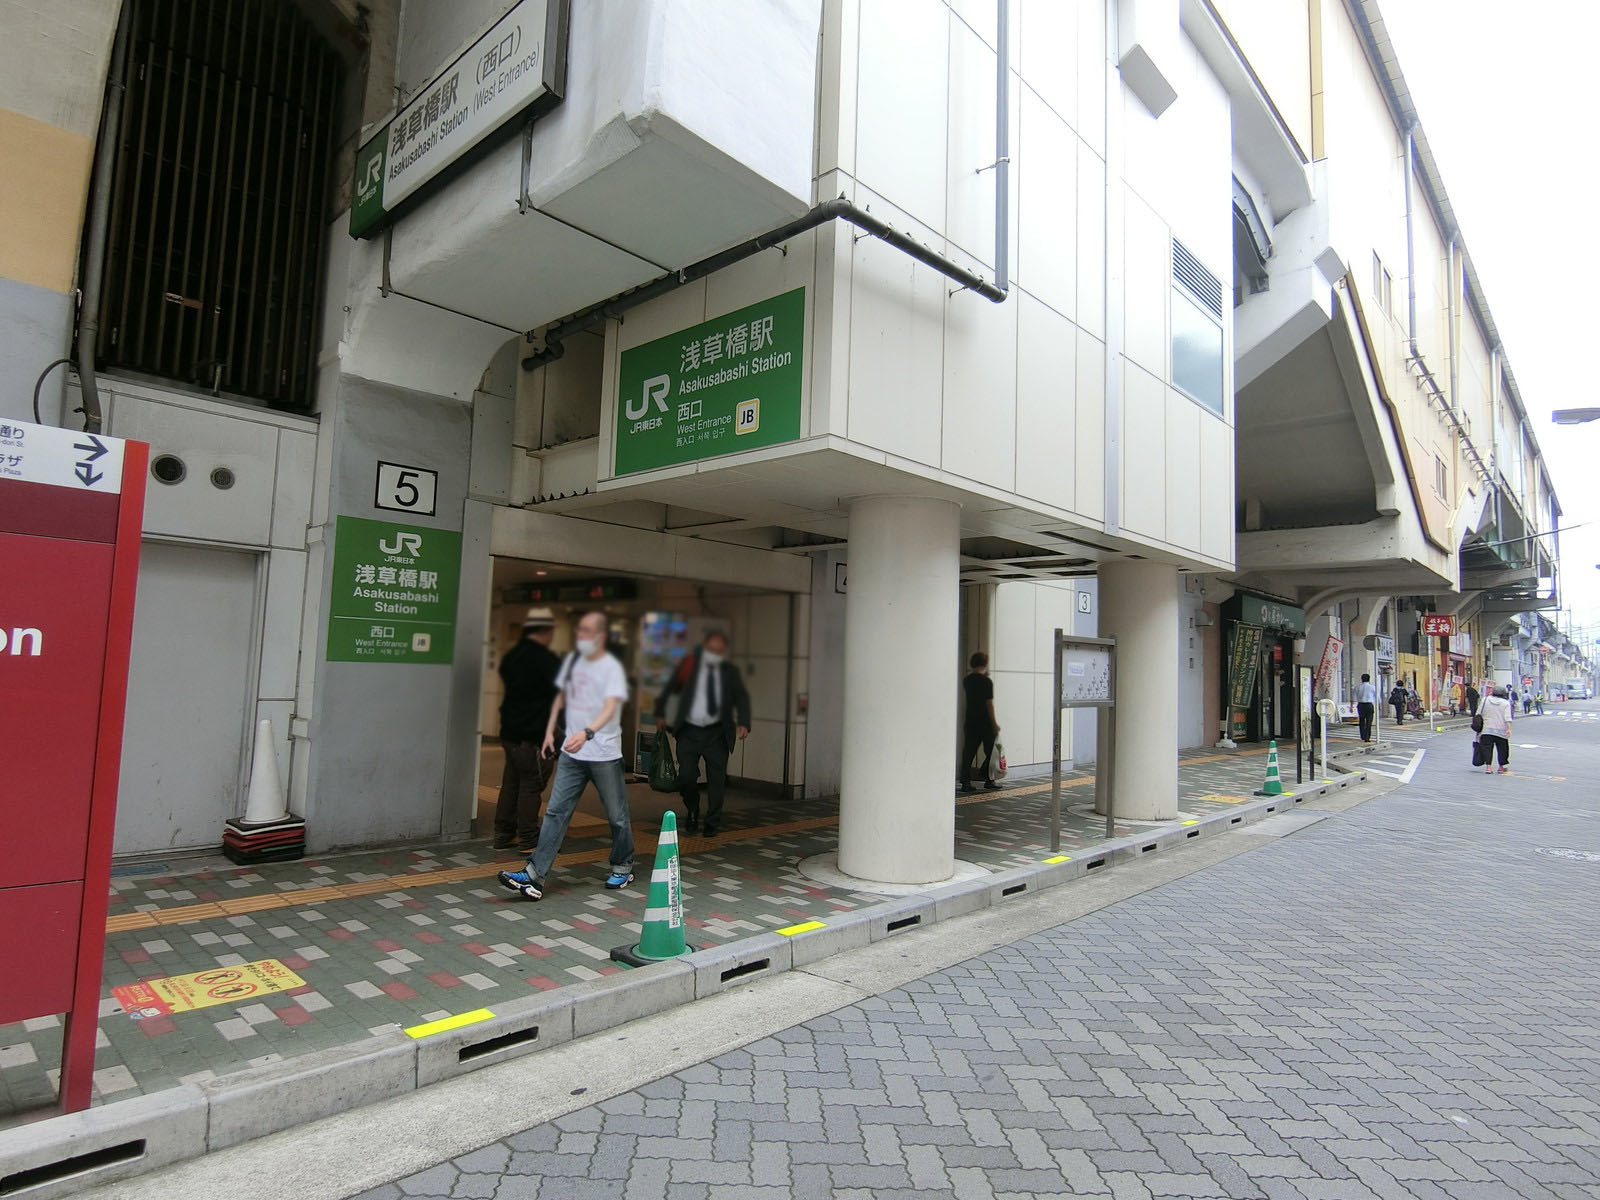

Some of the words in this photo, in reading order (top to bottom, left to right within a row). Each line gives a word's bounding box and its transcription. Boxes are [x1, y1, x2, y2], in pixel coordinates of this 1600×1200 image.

[388, 128, 439, 183] Asakusabashi
[439, 106, 469, 141] Station
[473, 82, 497, 116] (West
[498, 42, 540, 94] Entrance)
[390, 71, 460, 158] 浅草橋駅
[357, 152, 382, 196] JR
[679, 315, 774, 373] 浅草橋駅
[678, 360, 749, 396] Asakusabashi
[751, 351, 792, 375] Station
[625, 373, 671, 420] JR
[677, 399, 703, 423] 西口
[740, 408, 754, 425] JB
[629, 416, 663, 434] JR東日本
[676, 422, 697, 435] West
[697, 414, 732, 430] Entrance
[394, 471, 419, 507] 5
[379, 531, 422, 557] JR
[384, 555, 416, 565] JR東日本
[354, 563, 438, 590] 浅草橋駅
[352, 586, 439, 604] Asakusabashi
[1082, 594, 1088, 611] 3
[374, 601, 418, 615] Station
[370, 625, 395, 638] 西口
[1426, 623, 1450, 634] 王将
[355, 638, 375, 647] West
[376, 639, 408, 648] Entrance
